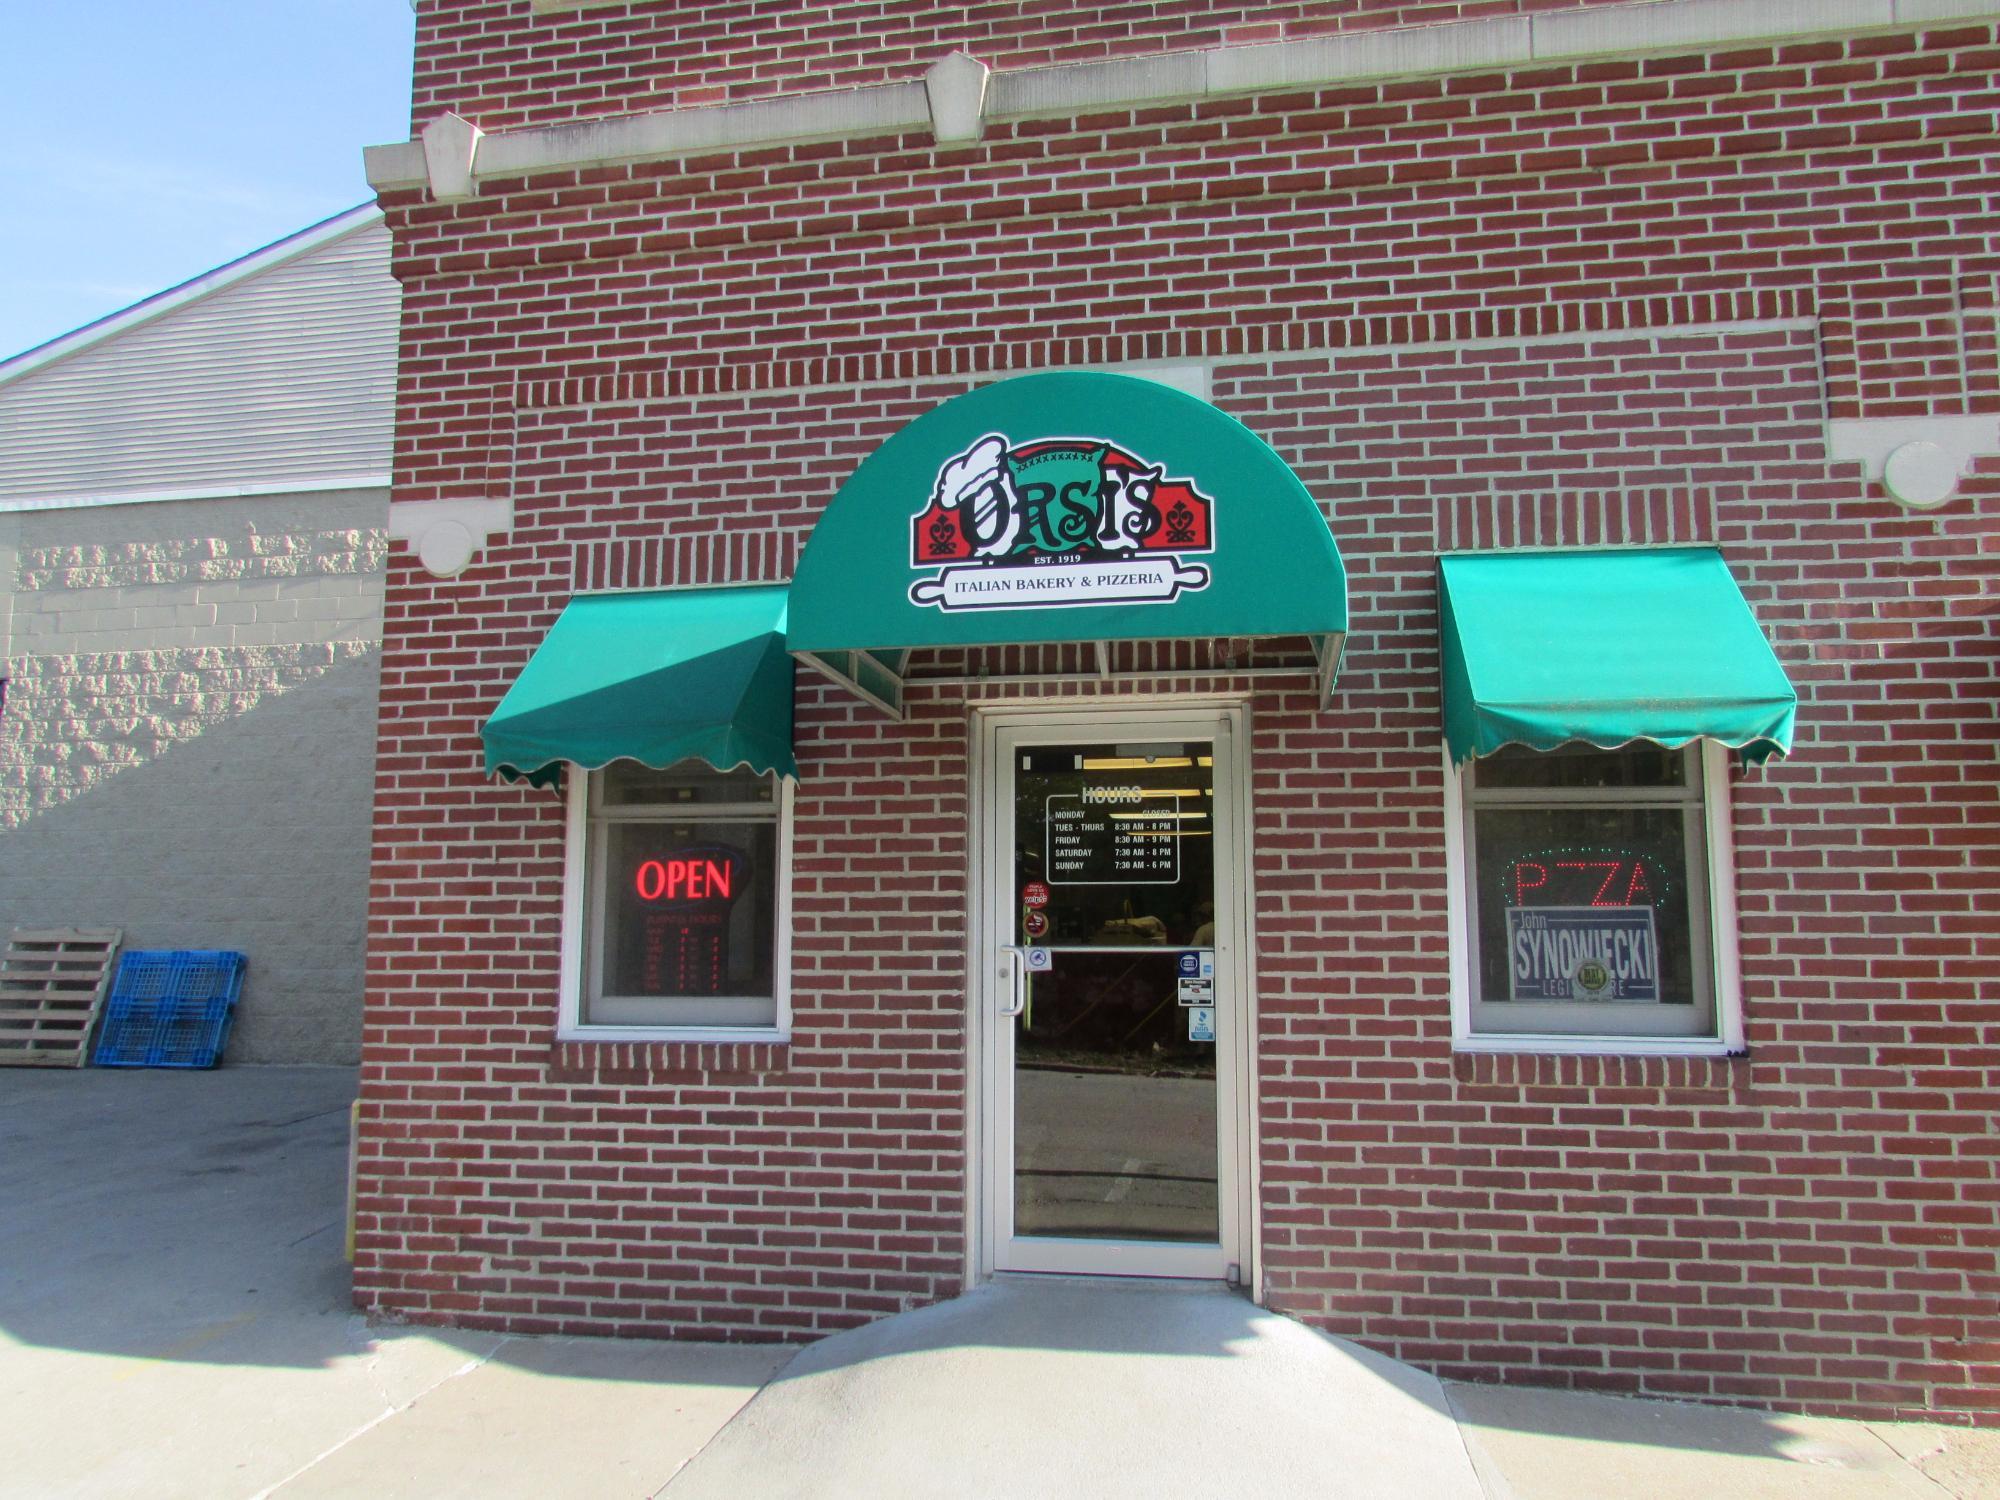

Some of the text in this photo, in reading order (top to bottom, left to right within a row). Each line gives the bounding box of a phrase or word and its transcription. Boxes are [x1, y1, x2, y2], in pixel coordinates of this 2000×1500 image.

[1034, 554, 1081, 565] EST. 1919
[954, 573, 1164, 593] ITALIAN BAKERY & PIZZERIA
[1082, 785, 1143, 804] HOURS
[1055, 811, 1085, 819] MONDAY
[1081, 823, 1105, 831] THURS
[1055, 836, 1081, 844] FRIDAY
[1115, 835, 1130, 843] 8:30
[1132, 835, 1144, 843] AM
[1159, 835, 1171, 843] PM
[1055, 849, 1092, 857] SATURDAY
[1115, 848, 1130, 856] 7:30
[1132, 848, 1144, 856] AM
[1152, 848, 1157, 856] 8
[1159, 848, 1171, 856] PM
[1055, 862, 1084, 870] SUNDAY
[1115, 861, 1130, 869] 7:30
[1132, 861, 1144, 869] AM
[1152, 861, 1157, 869] 6
[1159, 861, 1171, 869] PM
[636, 859, 731, 900] OPEN
[1519, 912, 1547, 929] John
[1516, 929, 1653, 980] SYNOWIECKI
